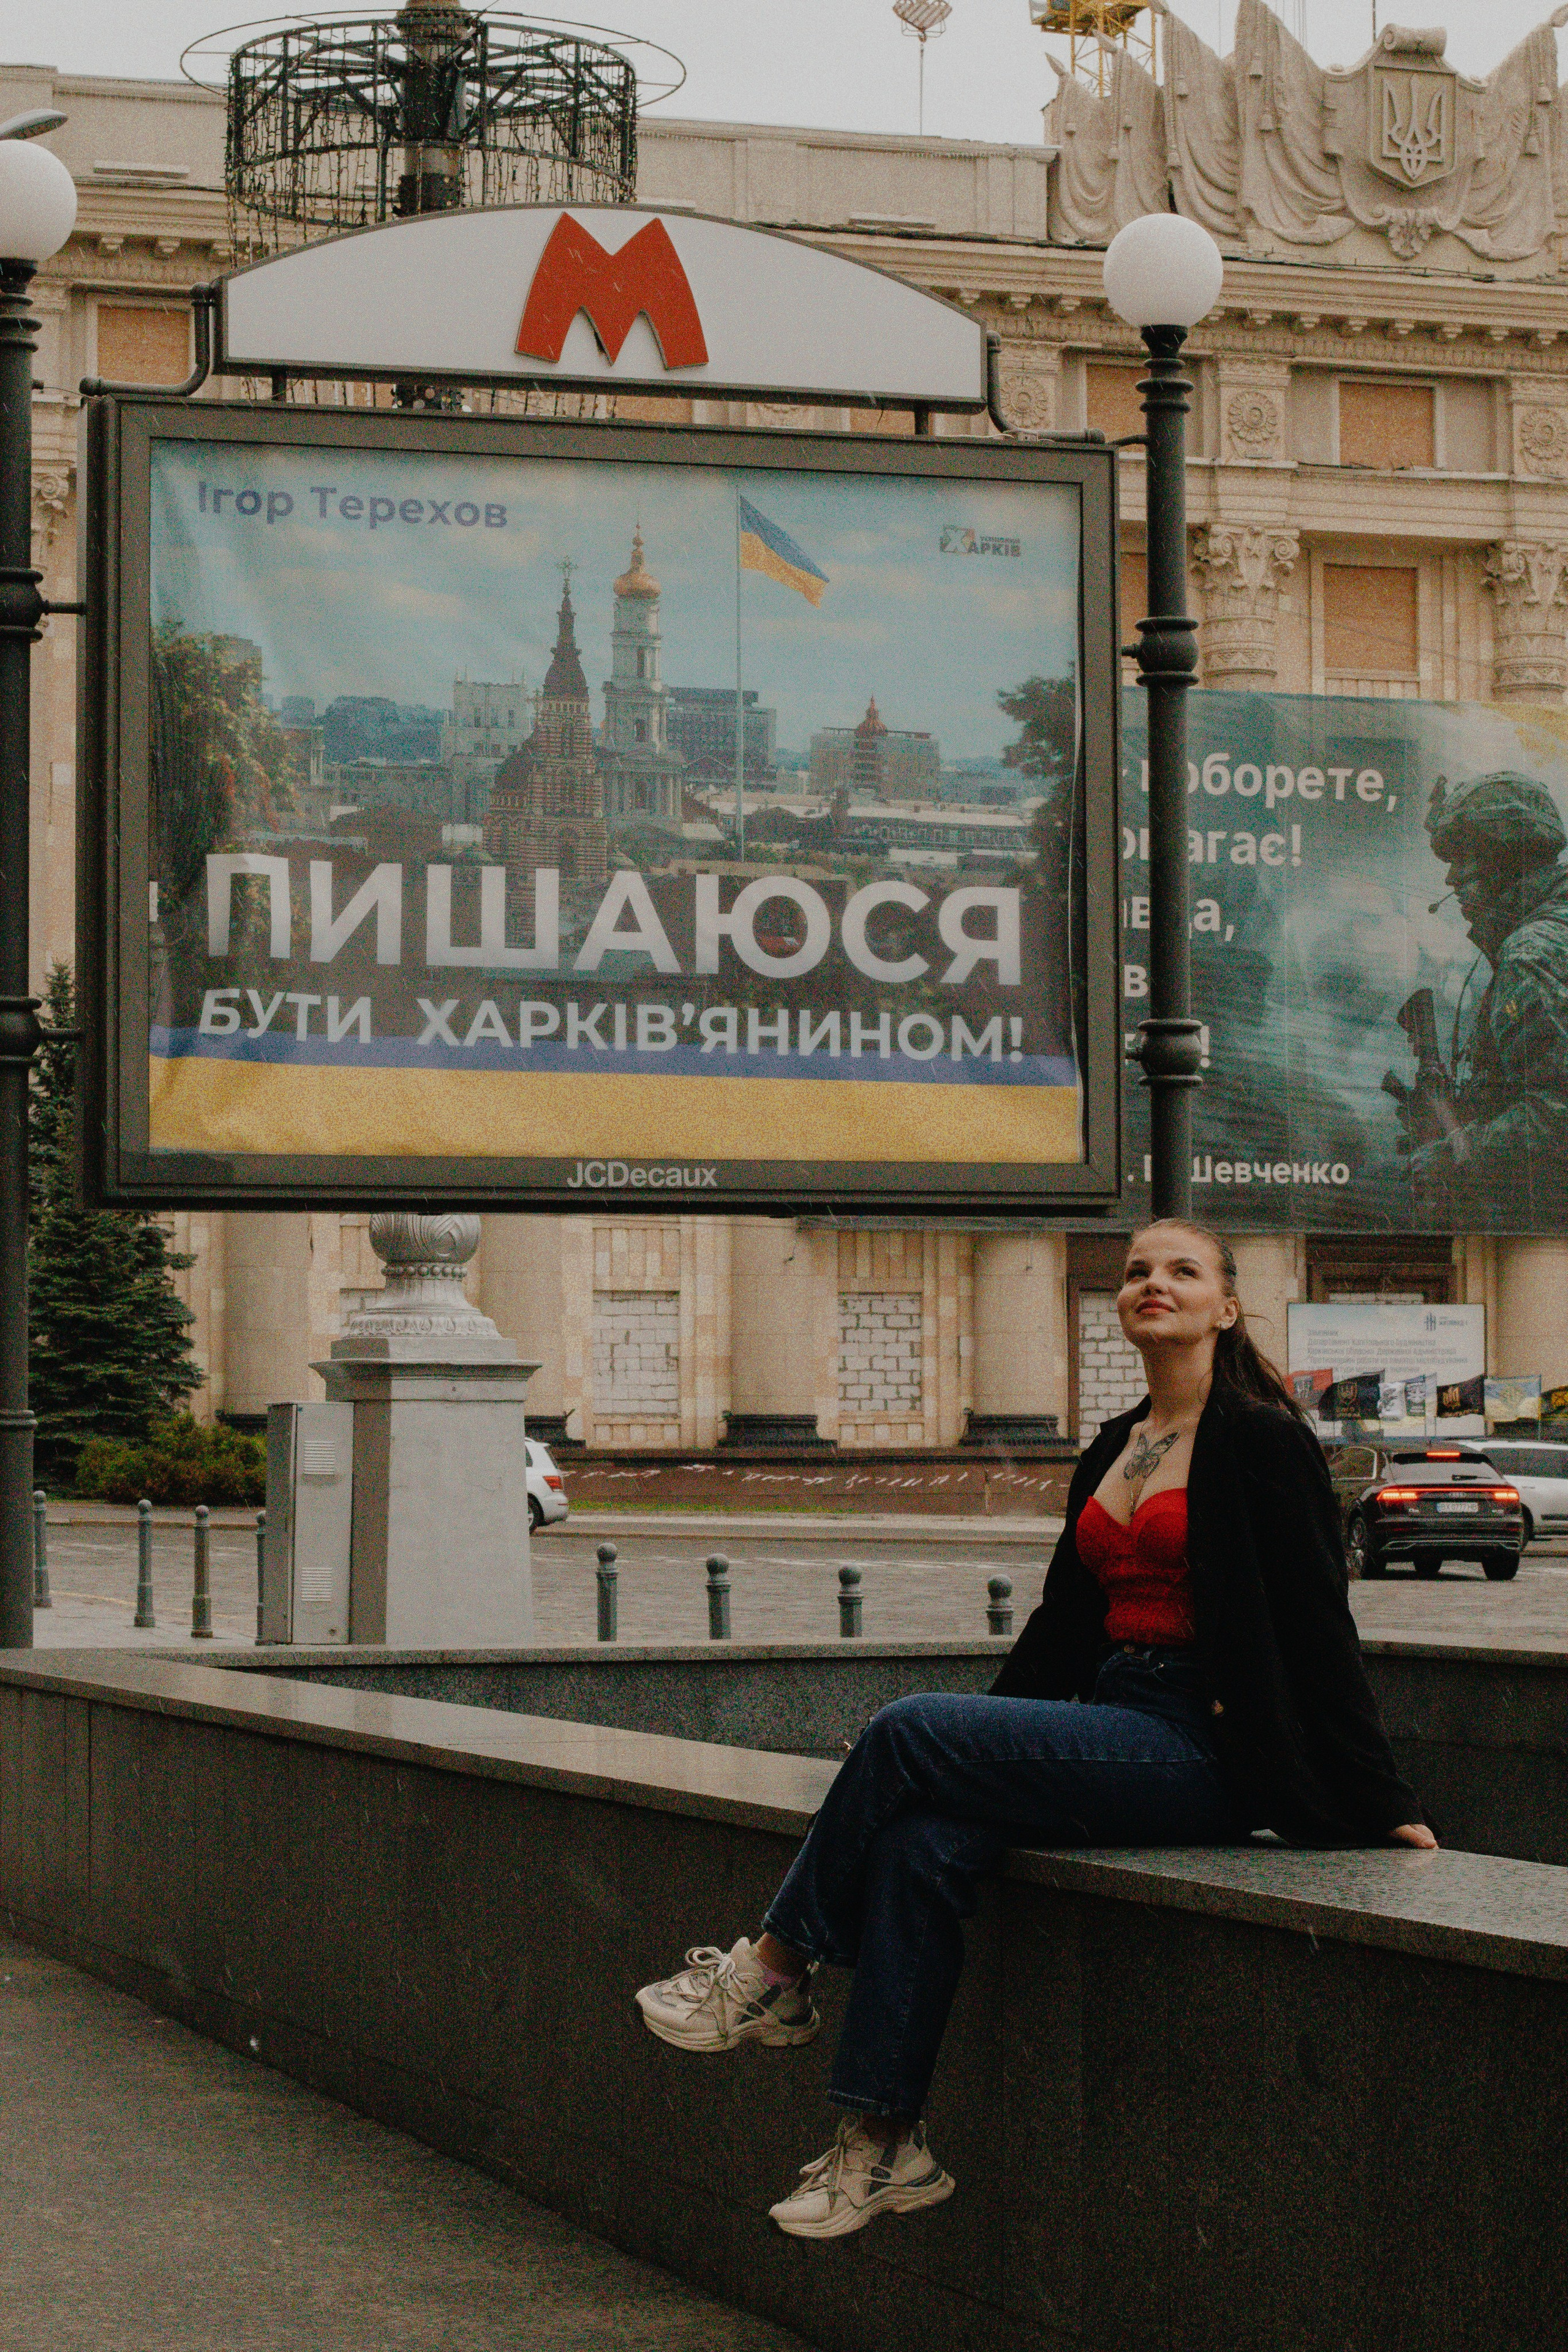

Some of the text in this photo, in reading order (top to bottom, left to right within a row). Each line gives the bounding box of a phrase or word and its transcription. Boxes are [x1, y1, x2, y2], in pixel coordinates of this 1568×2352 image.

[198, 481, 508, 530] Ігор Терехов
[942, 527, 1021, 557] ХАРКІВ
[206, 853, 1022, 986] ПИШАЮСЯ
[198, 988, 372, 1044] БУТИ
[567, 1161, 718, 1188] JCDecaux
